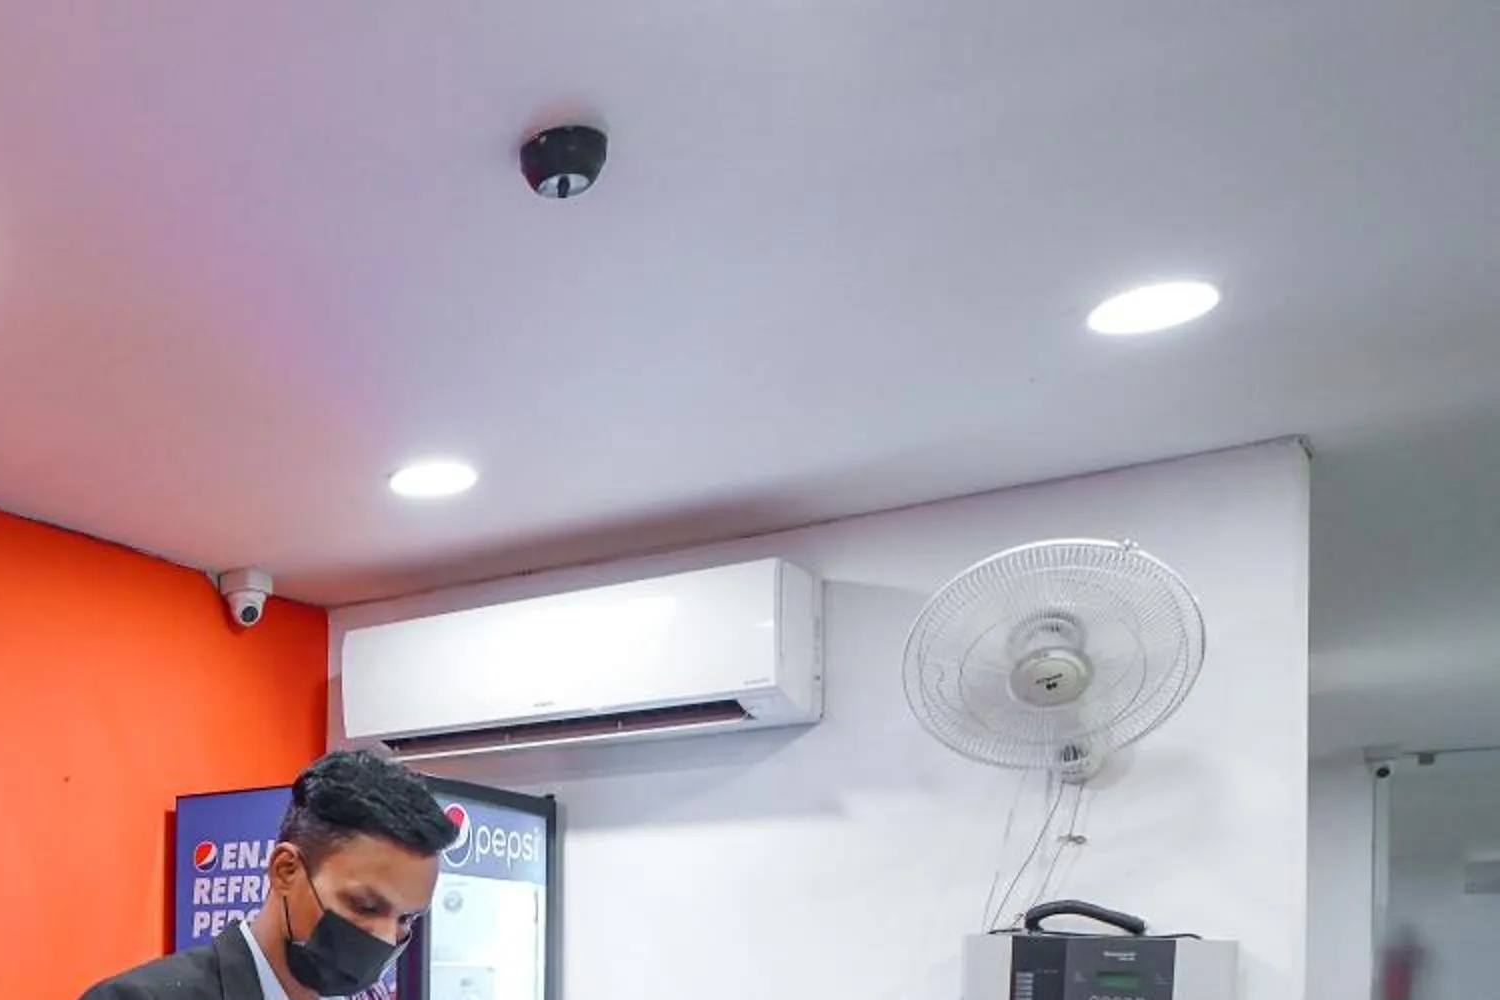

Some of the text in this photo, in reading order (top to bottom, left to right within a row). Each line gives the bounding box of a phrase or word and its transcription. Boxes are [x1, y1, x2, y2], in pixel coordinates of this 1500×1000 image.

[221, 839, 276, 870] ENJ
[475, 825, 541, 869] pepsi
[193, 875, 271, 905] REFR
